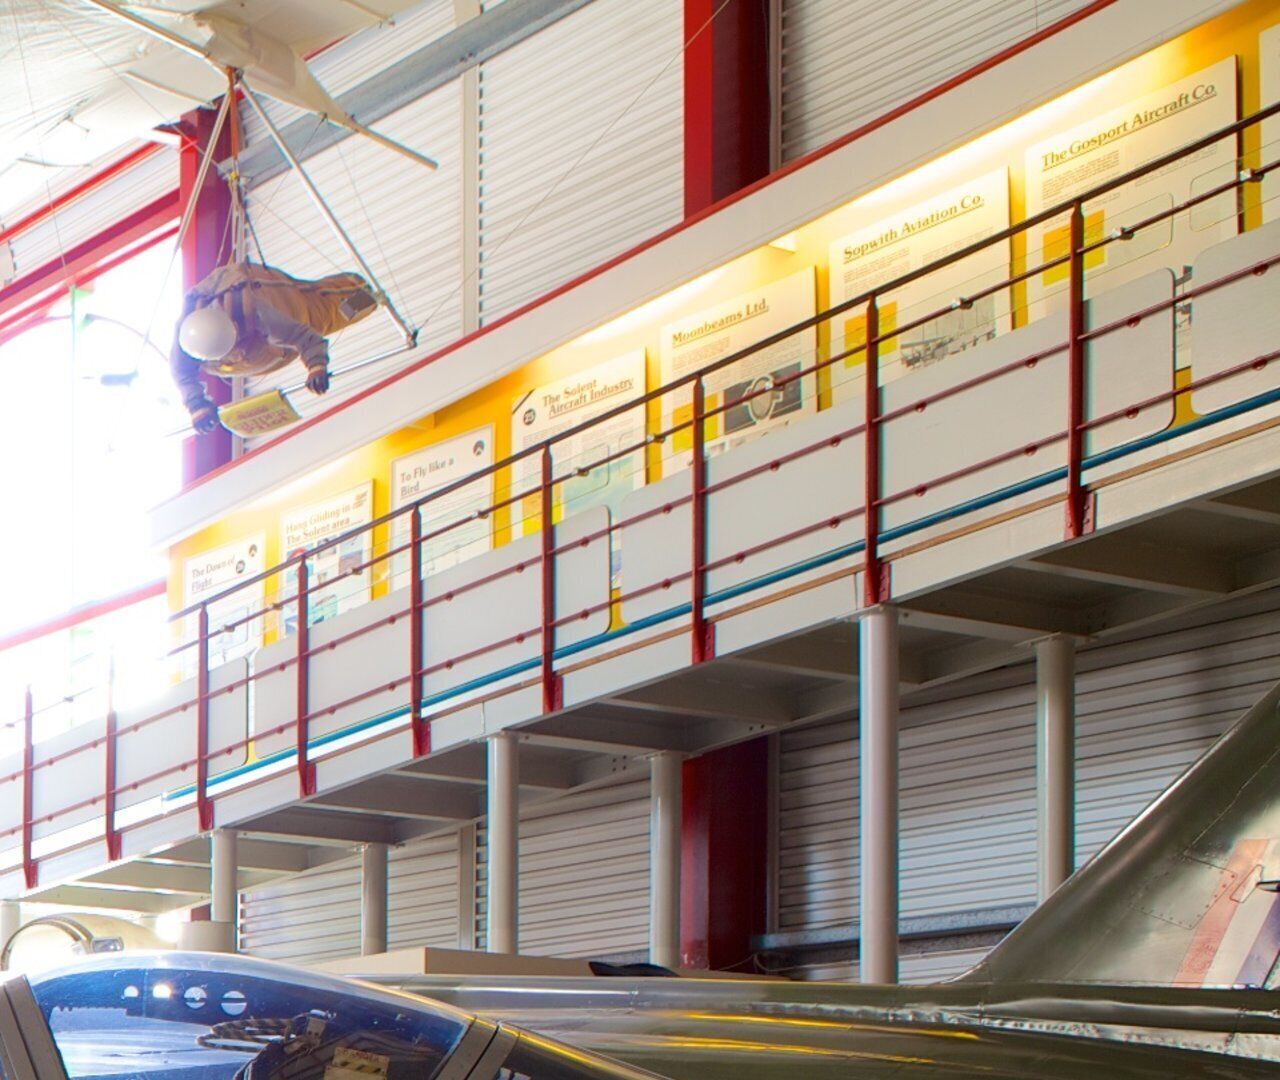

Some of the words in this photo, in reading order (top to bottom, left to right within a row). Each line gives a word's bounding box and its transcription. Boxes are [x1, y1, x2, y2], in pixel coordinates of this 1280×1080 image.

[1041, 149, 1067, 167] The
[1069, 121, 1128, 153] Gosport
[1132, 93, 1190, 127] Aircraft
[843, 229, 897, 258] Sopwith
[901, 204, 958, 234] Aviation
[672, 312, 743, 343] Moonbeams
[746, 298, 769, 316] Ltd.
[542, 393, 560, 407] The
[564, 379, 597, 397] Solent
[549, 395, 587, 414] Aircraft
[590, 378, 634, 400] Industry
[400, 482, 420, 497] Bird
[401, 472, 411, 483] To
[414, 466, 426, 478] Fly
[428, 460, 445, 473] like
